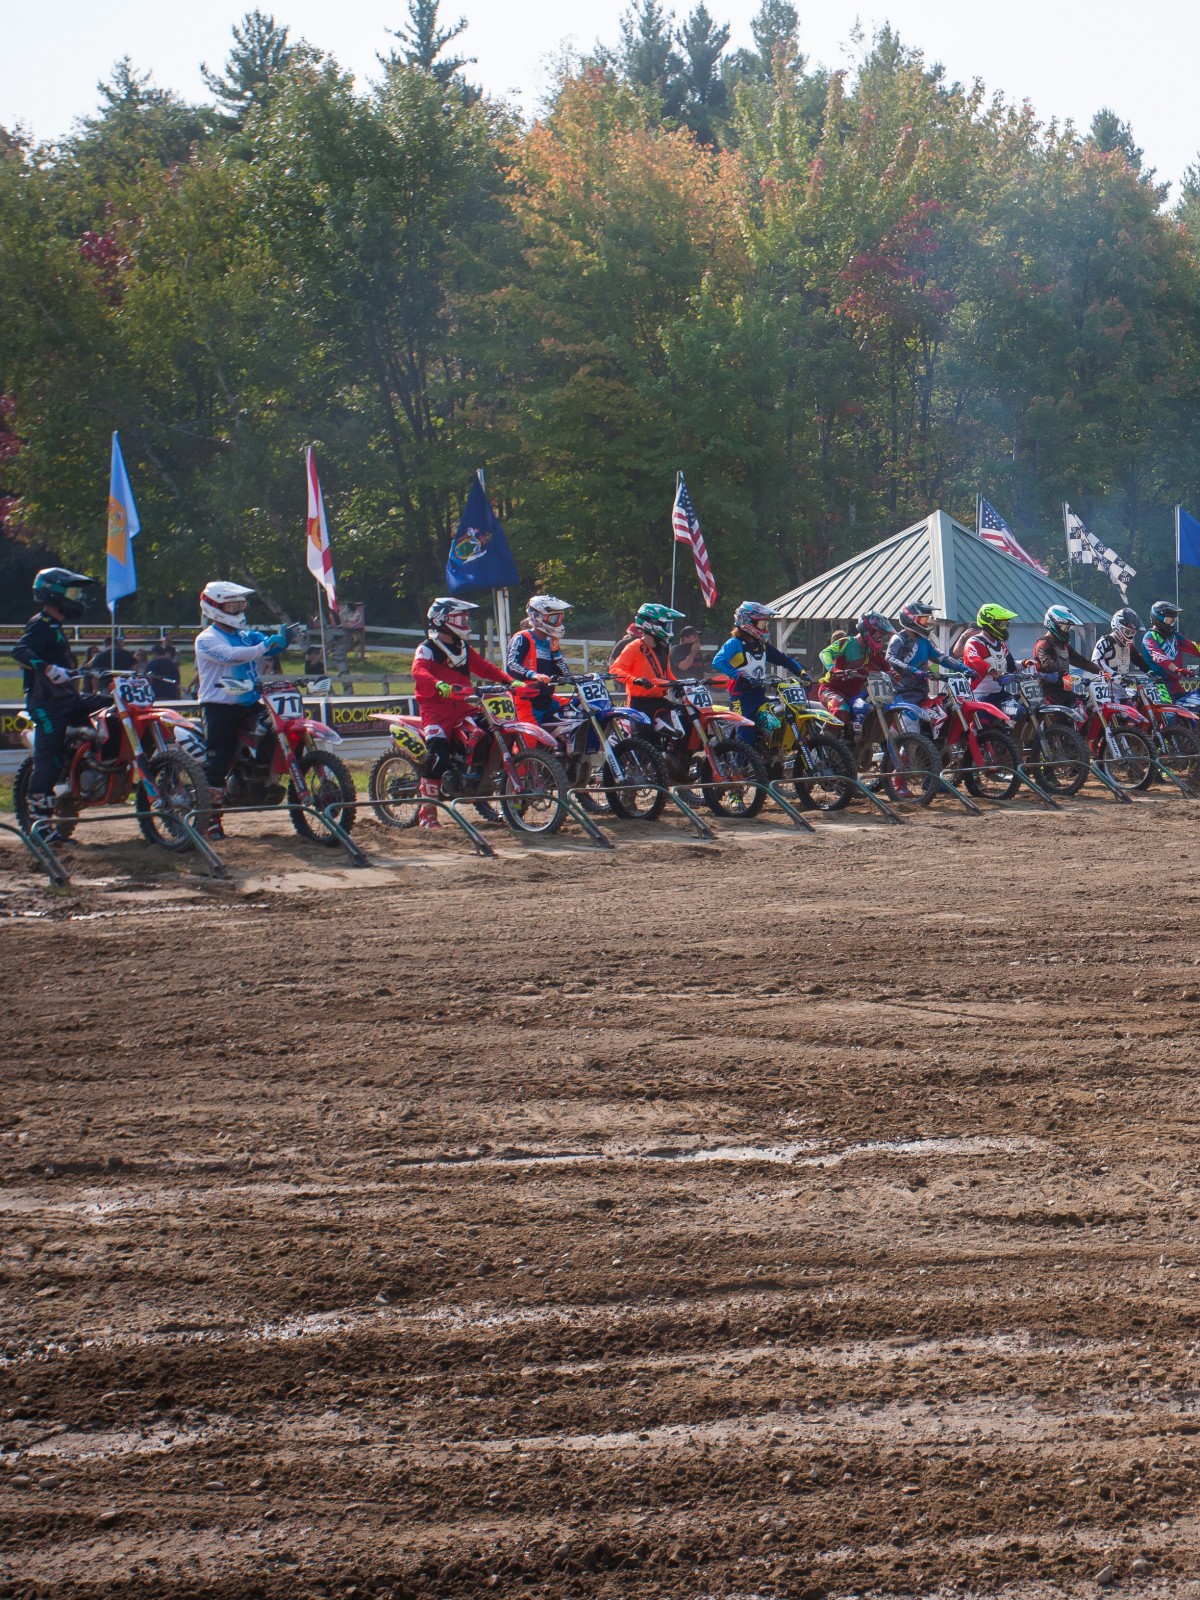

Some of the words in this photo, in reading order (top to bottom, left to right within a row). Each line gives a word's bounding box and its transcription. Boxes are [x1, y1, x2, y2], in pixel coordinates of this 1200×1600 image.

[120, 684, 156, 705] 859
[582, 685, 608, 702] 824
[693, 692, 712, 708] 49
[783, 687, 807, 704] 183
[488, 698, 515, 717] 318
[391, 728, 424, 755] 318
